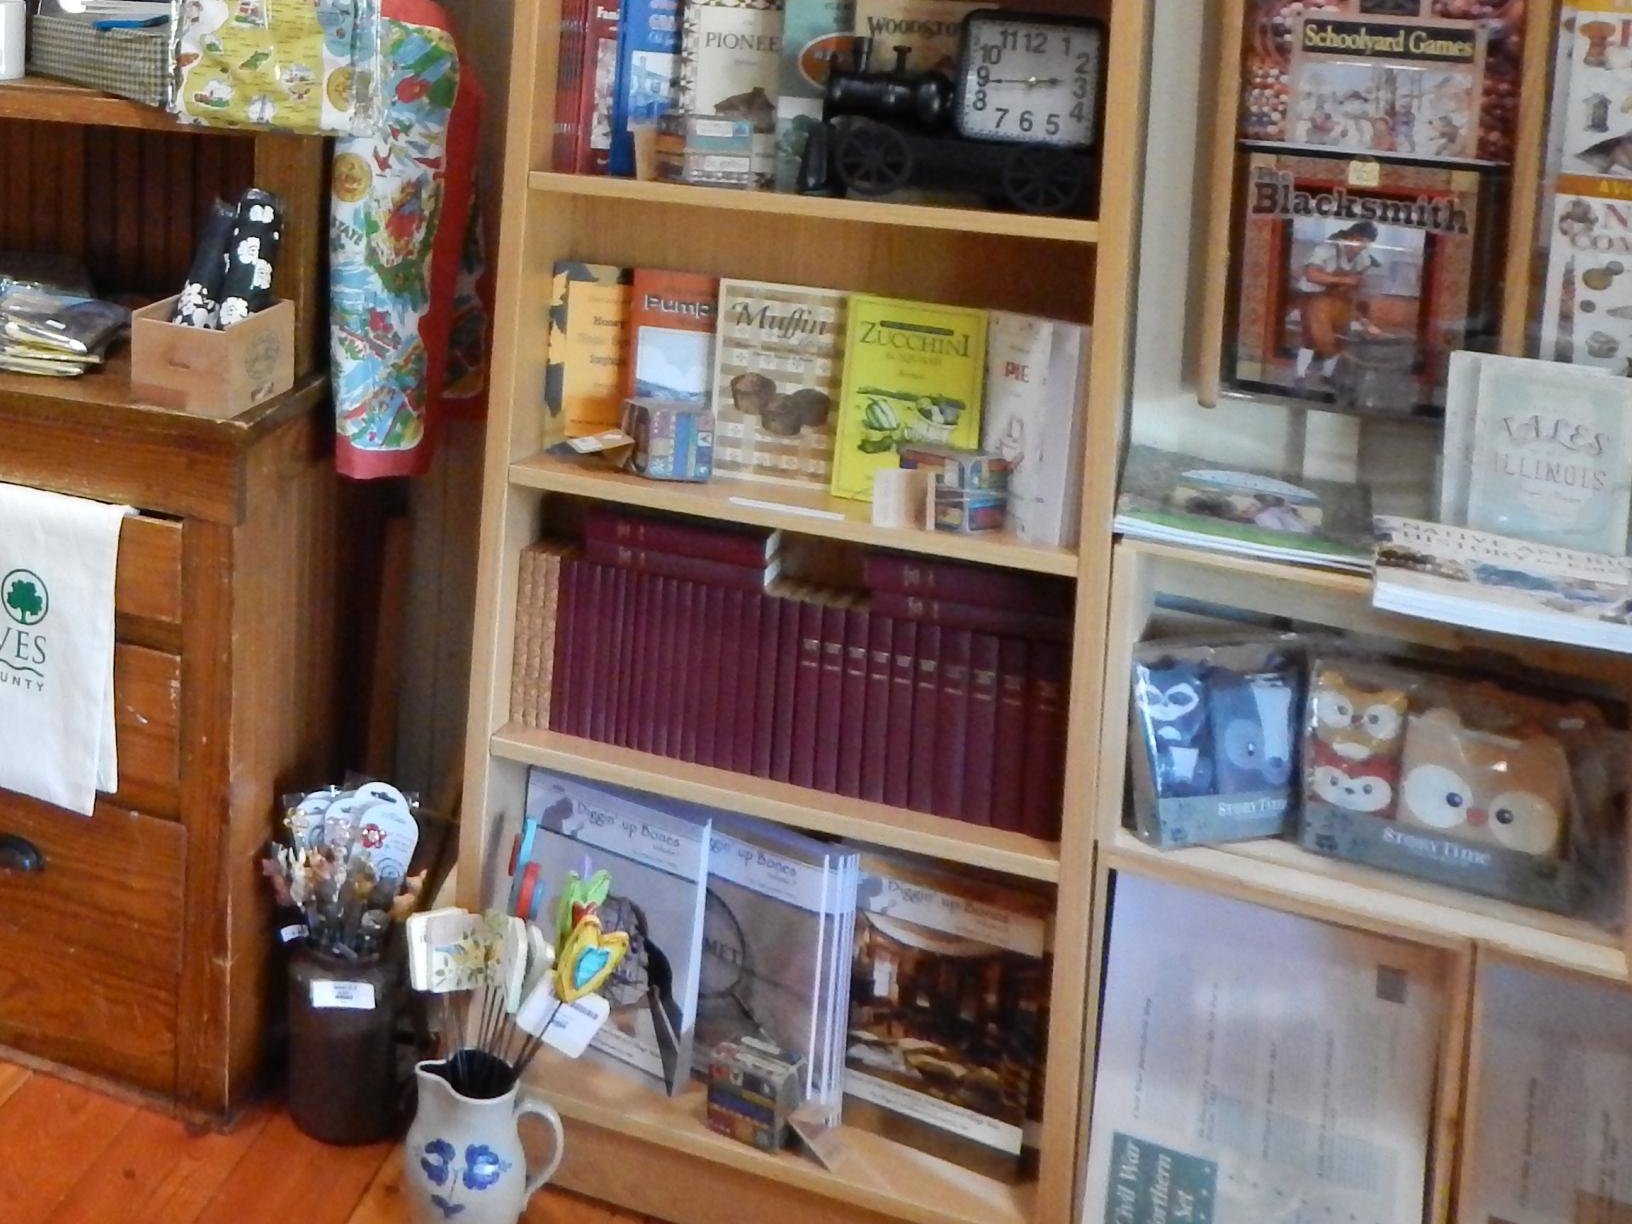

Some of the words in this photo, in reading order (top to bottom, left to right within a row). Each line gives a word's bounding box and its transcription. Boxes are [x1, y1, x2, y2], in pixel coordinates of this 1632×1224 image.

[1000, 29, 1019, 50] 11
[1024, 32, 1049, 54] 12
[1062, 36, 1071, 56] 1
[1304, 24, 1406, 54] Schoolyard
[1409, 31, 1473, 57] Games
[981, 44, 1003, 65] 10
[1075, 53, 1090, 74] 2
[976, 66, 990, 87] 9
[1073, 78, 1088, 98] 3
[973, 90, 987, 111] 8
[995, 108, 1009, 128] 7
[1019, 110, 1033, 132] 6
[1070, 102, 1085, 123] 4
[1045, 114, 1060, 136] 5
[1253, 182, 1468, 234] Blacksmith
[732, 301, 827, 339] Muffin
[859, 320, 971, 358] ZUCCHINI
[1005, 361, 1030, 382] PIE
[1494, 453, 1606, 491] ILLINOIS
[622, 821, 637, 837] up
[641, 825, 681, 847] Bones
[738, 850, 753, 866] up
[757, 854, 798, 877] Bones
[1118, 1139, 1141, 1181] War
[1144, 1154, 1172, 1224] orthern
[1173, 1189, 1192, 1220] Set
